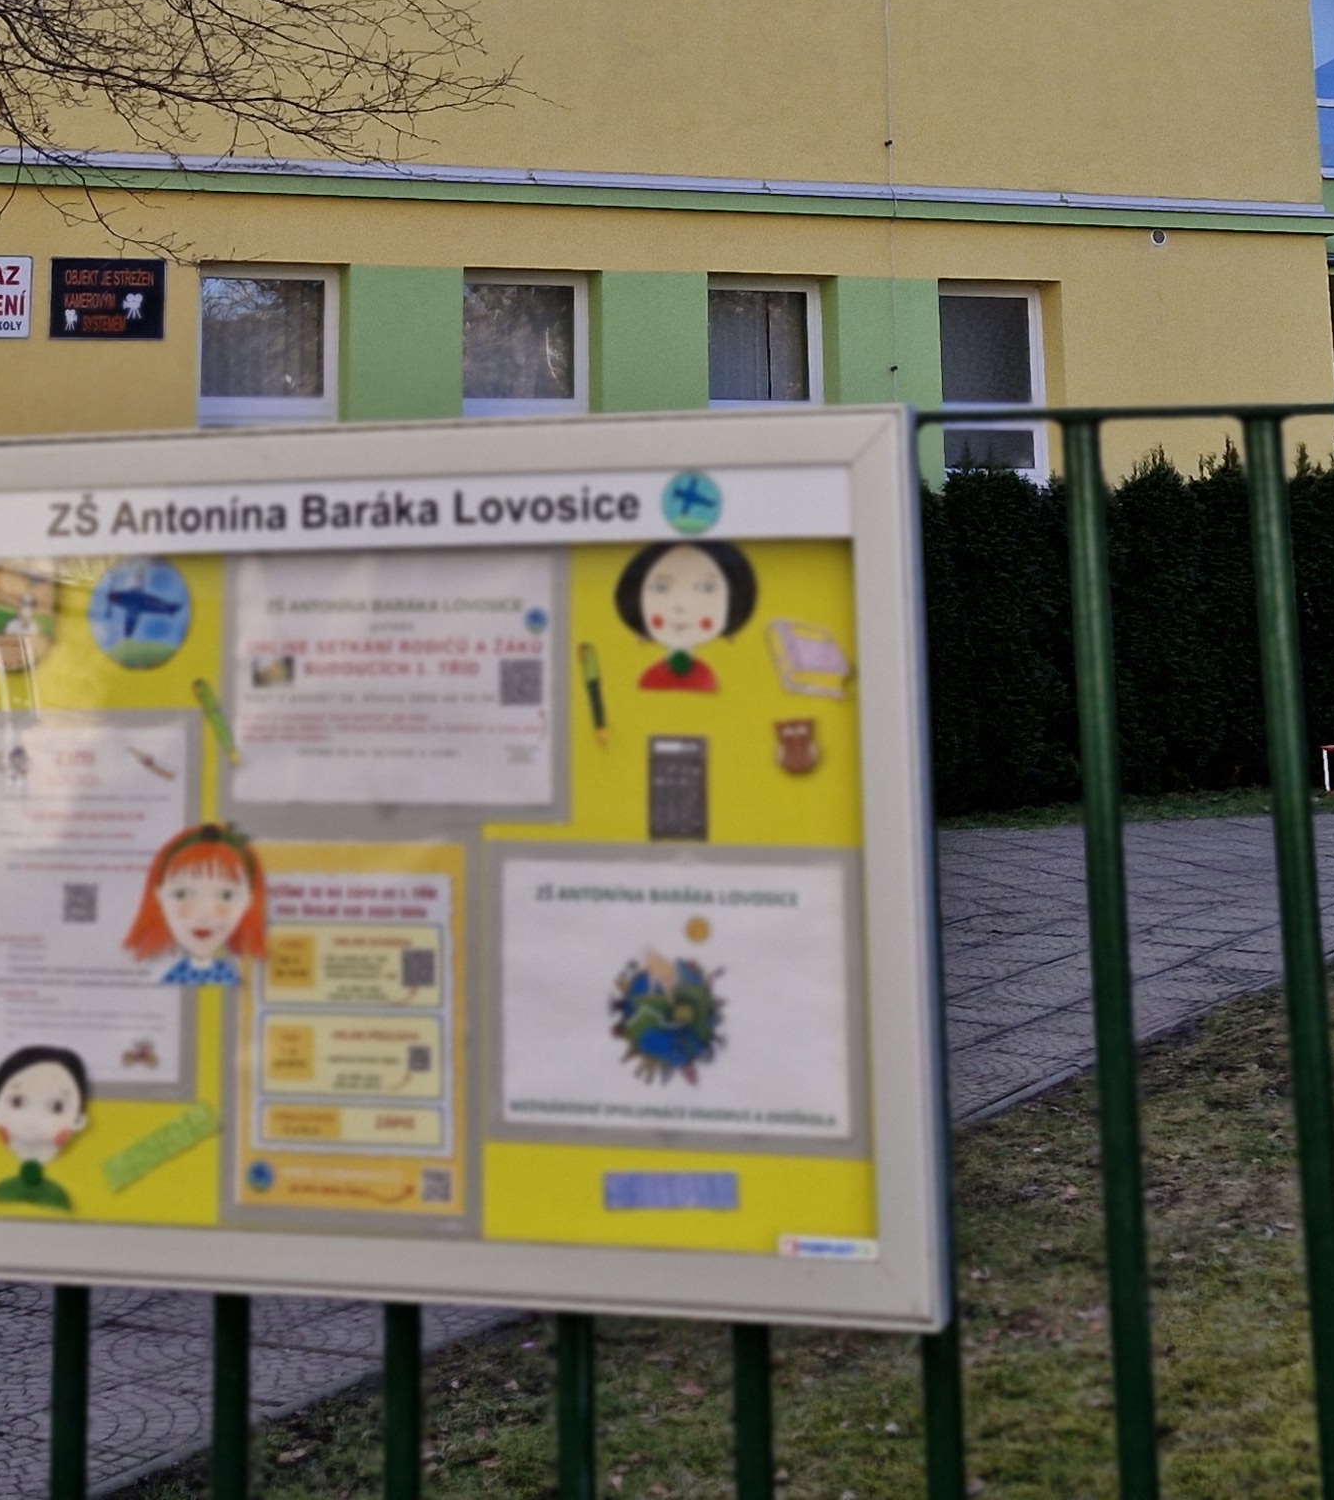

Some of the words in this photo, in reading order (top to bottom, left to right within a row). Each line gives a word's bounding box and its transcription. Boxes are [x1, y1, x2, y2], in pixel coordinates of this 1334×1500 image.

[65, 269, 99, 286] OBJEKT
[100, 270, 113, 286] JE
[113, 267, 155, 287] STŘEŽEN
[47, 493, 101, 538] ZŠ
[110, 495, 288, 537] Antonína
[300, 491, 441, 531] Baráka
[454, 485, 641, 526] Lovosice
